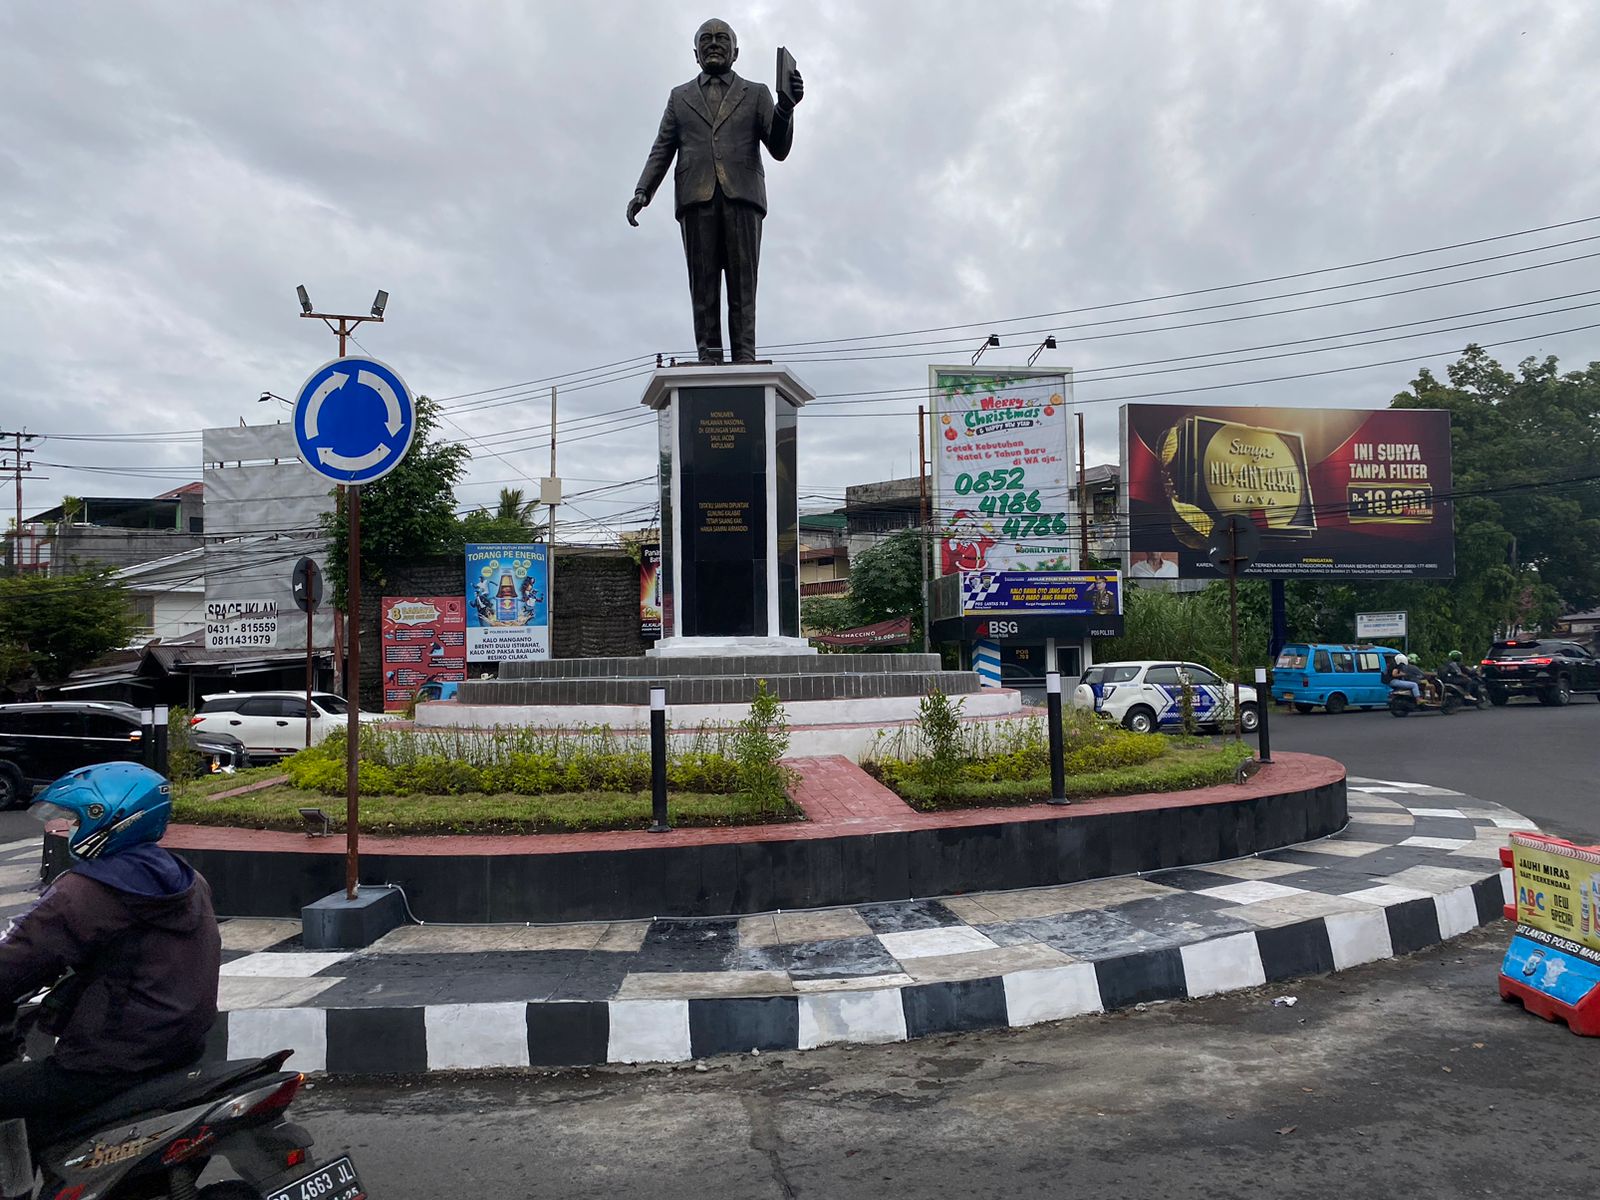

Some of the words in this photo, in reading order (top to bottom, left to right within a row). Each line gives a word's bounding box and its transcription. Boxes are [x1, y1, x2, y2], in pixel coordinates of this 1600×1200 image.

[980, 396, 1023, 411] Merry
[964, 407, 1040, 427] Christmas
[946, 443, 973, 453] Cetak
[975, 441, 1024, 451] Kebutuhan
[957, 451, 982, 461] Natal
[985, 451, 992, 459] &
[994, 449, 1021, 458] Tahun
[1024, 448, 1046, 456] Baru
[1229, 438, 1275, 463] Surya
[1354, 443, 1373, 460] INI
[1377, 443, 1421, 461] SURYA
[1013, 458, 1021, 466] di
[1024, 456, 1039, 464] WA
[1210, 461, 1297, 493] NUSANTARA
[1349, 463, 1386, 479] TANPA
[1389, 463, 1428, 479] FILTER
[954, 467, 1025, 496] 0852
[978, 489, 1042, 518] 4186
[1233, 493, 1277, 505] RAYA
[1001, 512, 1067, 540] 4786
[468, 551, 502, 561] TORANG
[515, 551, 545, 561] ENERGI
[208, 602, 242, 620] SPACE
[245, 601, 277, 620] IKLAN
[207, 624, 230, 634] 0431
[241, 622, 276, 633] 815559
[989, 621, 1018, 634] BSG
[212, 635, 271, 646] 0811431979
[1519, 858, 1541, 873] JAUHI
[1542, 864, 1570, 880] MIRAS
[1532, 874, 1571, 891] BERKENDARA
[1520, 886, 1545, 911] ABC
[1553, 894, 1569, 909] NEW
[1551, 908, 1574, 927] SPECIAL
[1515, 924, 1528, 935] SAT
[1526, 926, 1552, 943] LANTAS
[1551, 935, 1580, 953] POLRES
[300, 1173, 333, 1200] 4663
[337, 1164, 353, 1183] JL
